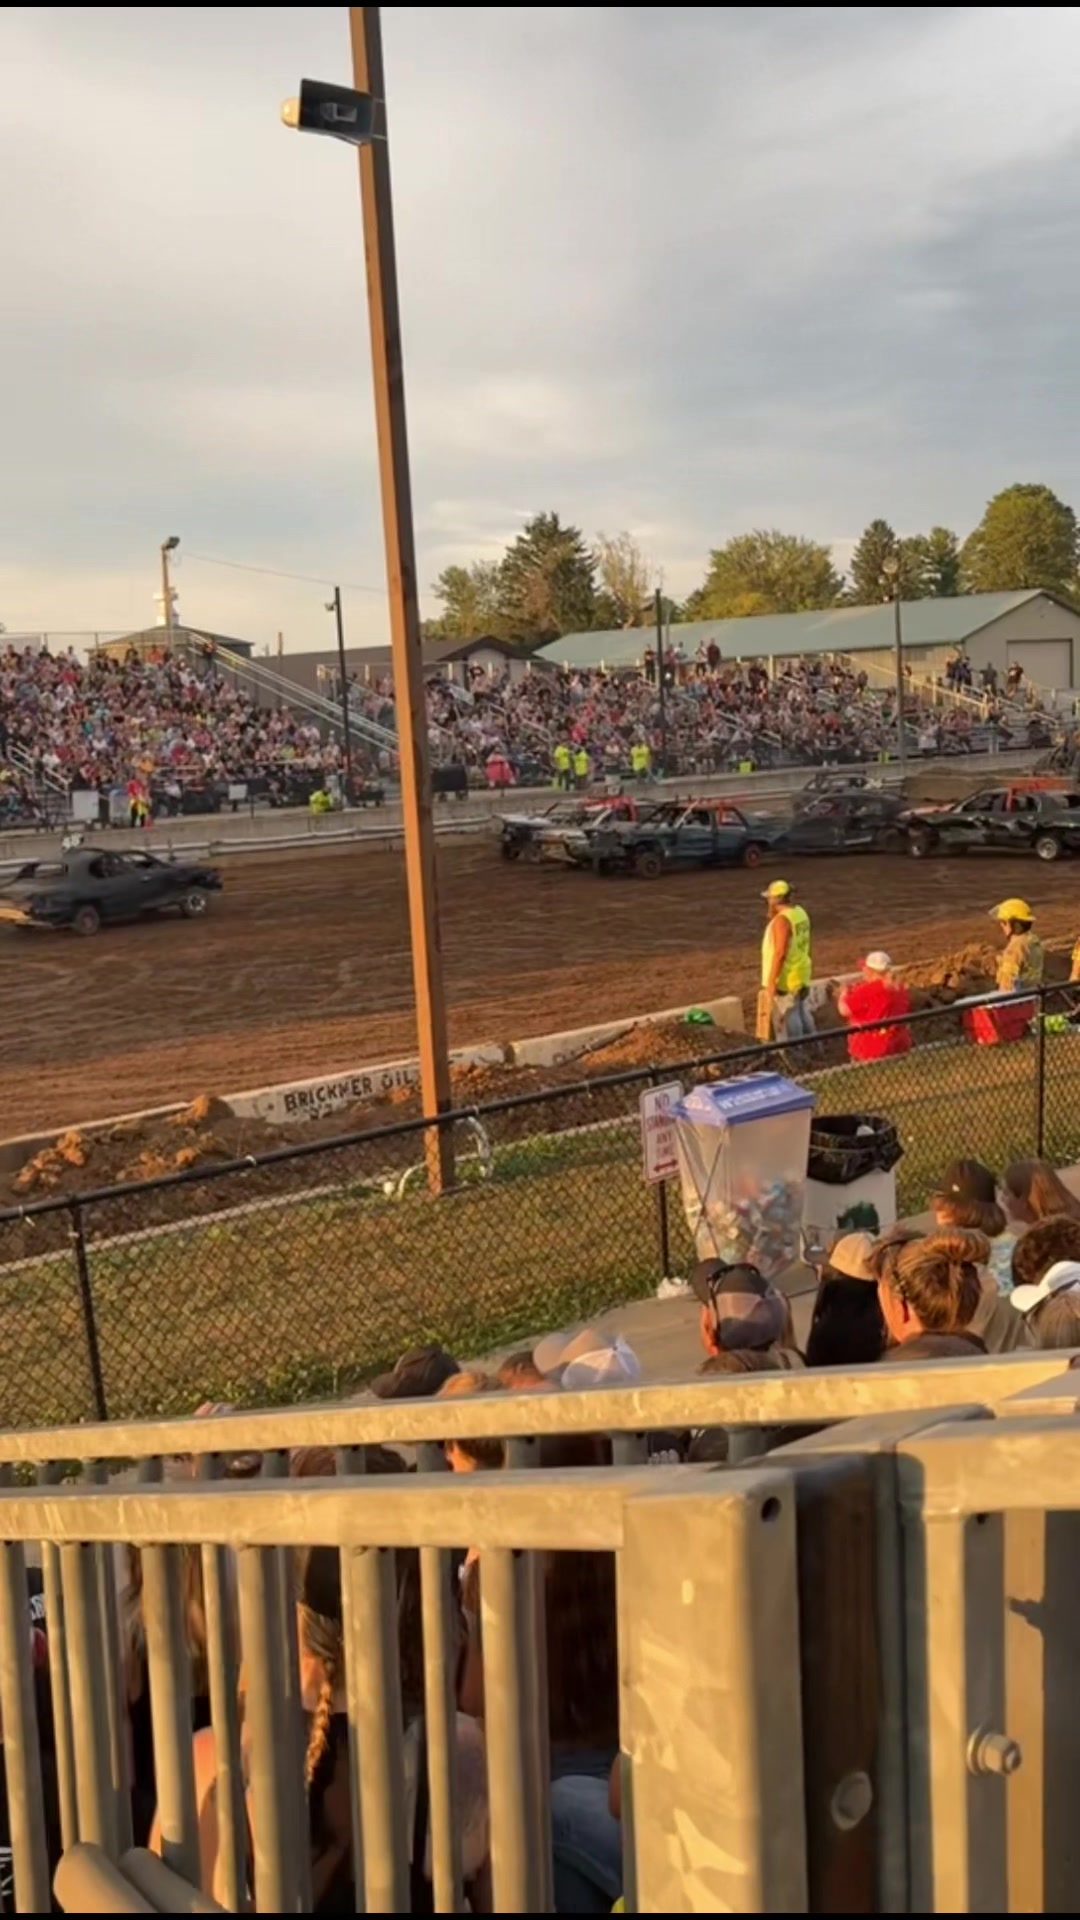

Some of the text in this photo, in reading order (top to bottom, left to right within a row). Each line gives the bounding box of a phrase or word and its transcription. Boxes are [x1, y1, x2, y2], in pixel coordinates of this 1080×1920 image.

[283, 1076, 373, 1113] BRICKNER
[380, 1070, 414, 1090] OIL
[654, 1093, 670, 1112] NO
